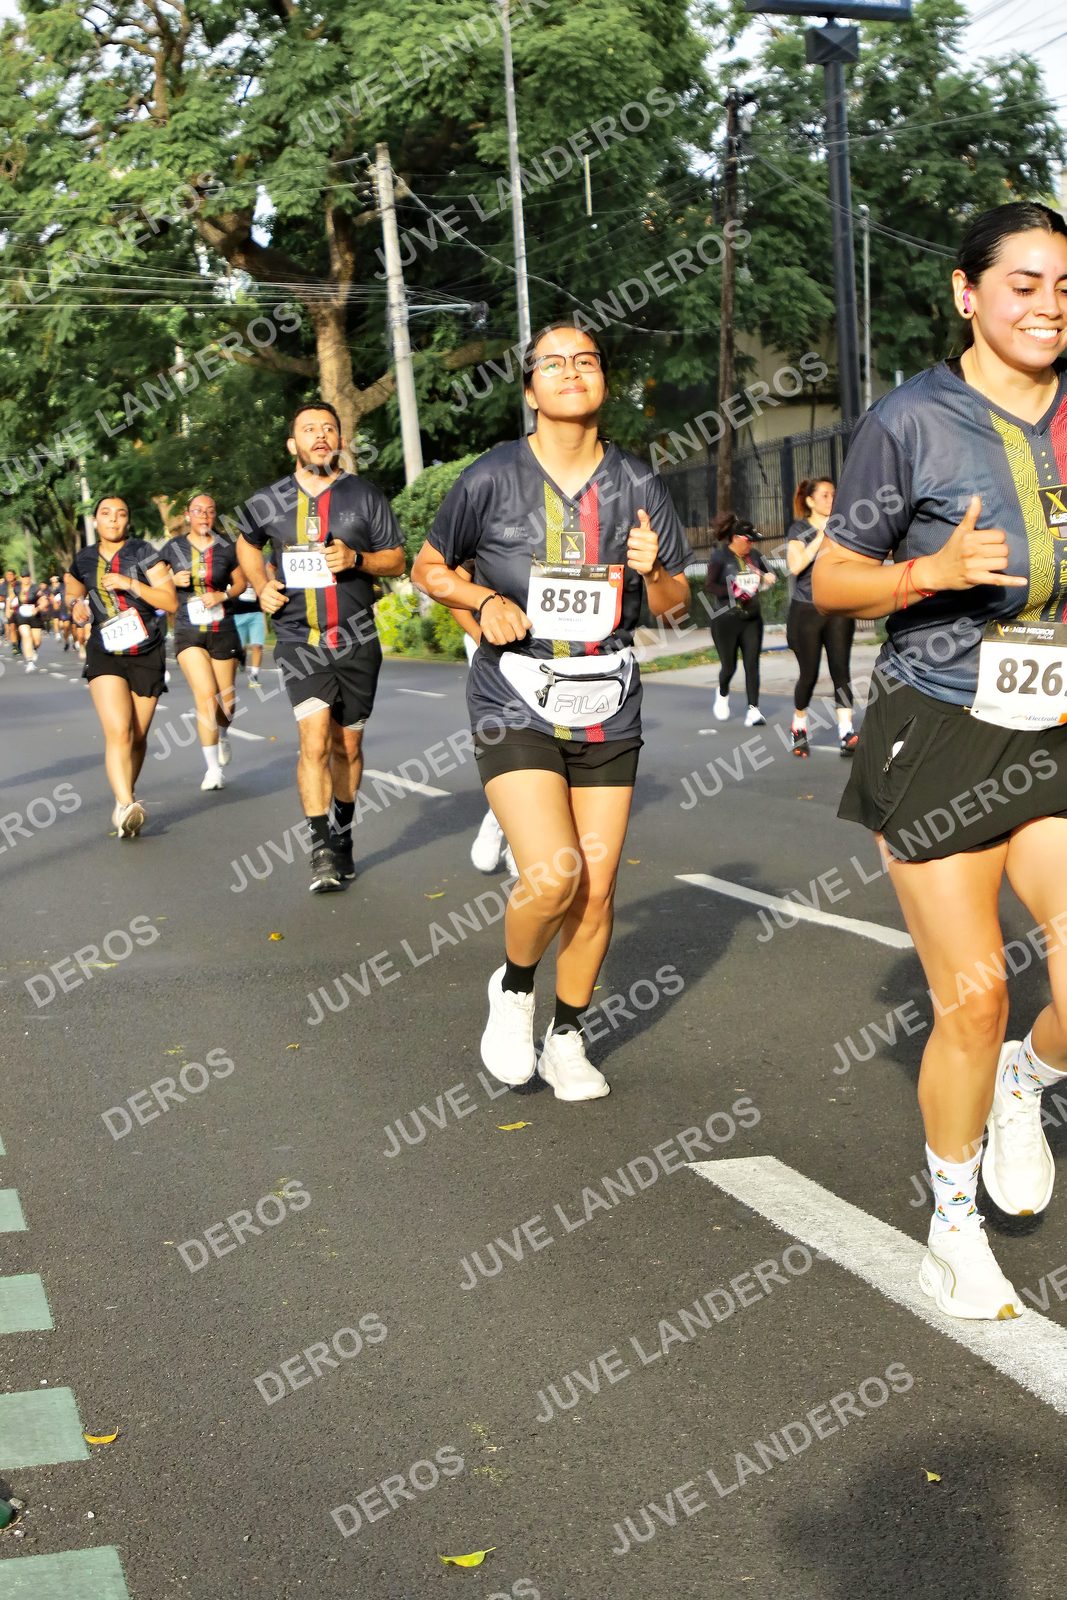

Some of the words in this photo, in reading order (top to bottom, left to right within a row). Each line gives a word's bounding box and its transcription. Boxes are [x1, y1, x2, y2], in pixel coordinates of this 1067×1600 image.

[290, 558, 322, 572] 8433
[540, 588, 601, 614] 8581
[996, 658, 1067, 696] 826
[554, 694, 609, 714] FILA
